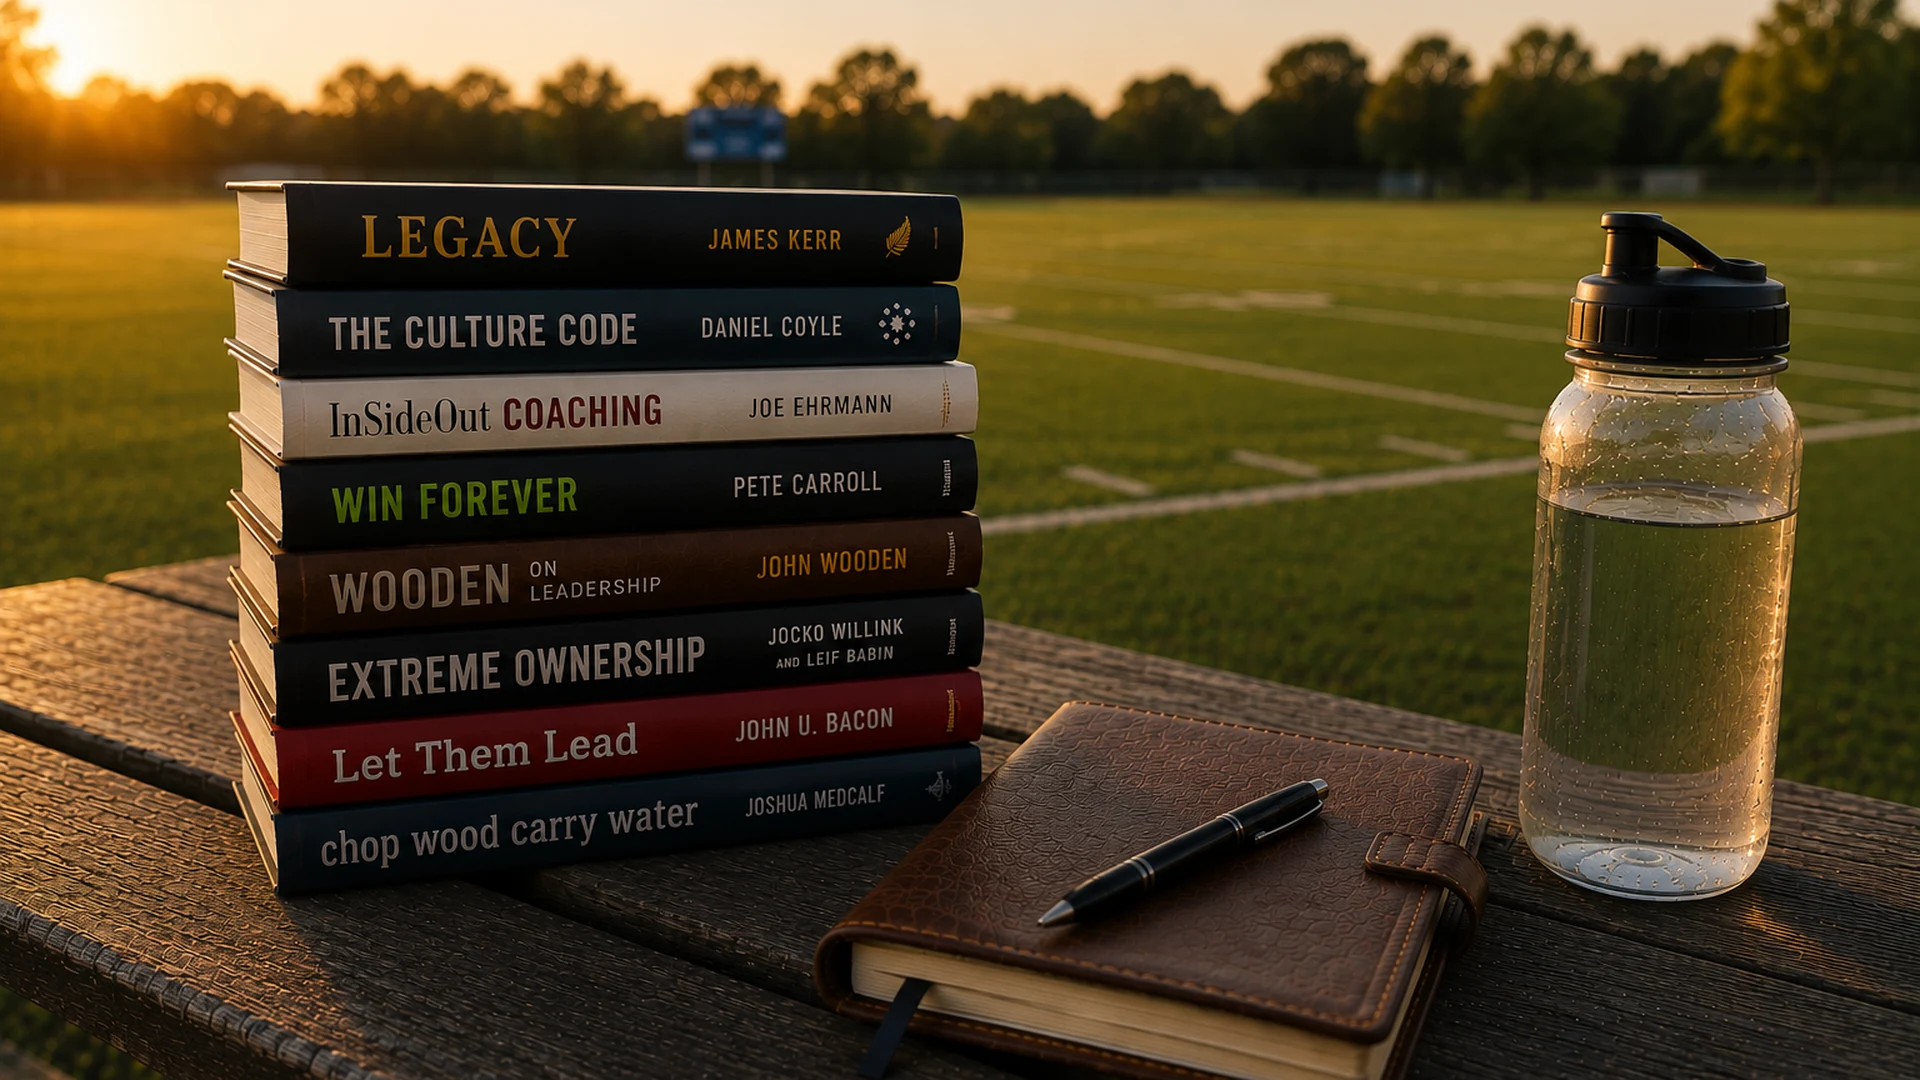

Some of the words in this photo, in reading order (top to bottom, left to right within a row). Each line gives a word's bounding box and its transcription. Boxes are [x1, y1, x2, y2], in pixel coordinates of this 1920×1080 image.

[362, 215, 576, 258] LEGACY
[709, 229, 778, 249] JAMES
[789, 230, 840, 250] KERR
[329, 317, 391, 350] THE
[406, 315, 545, 349] CULTURE
[559, 314, 636, 345] CODE
[702, 317, 773, 338] DANIEL
[782, 316, 841, 336] COYLE
[329, 399, 491, 437] InSideOut
[504, 394, 661, 430] COACHING
[749, 398, 784, 417] JOE
[795, 395, 891, 416] EHRMANN
[332, 485, 402, 523] WIN
[420, 477, 577, 519] FOREVER
[735, 475, 782, 497] PETE
[793, 471, 881, 494] CARROLL
[530, 561, 556, 577] ON
[757, 554, 810, 578] JOHN
[821, 548, 906, 574] WOODEN
[329, 564, 509, 614] WOODEN
[531, 577, 660, 601] LEADERSHIP
[769, 625, 823, 645] JOCKO
[831, 618, 903, 640] WILLINK
[329, 651, 500, 702] EXTREME
[515, 636, 704, 686] OWNERSHIP
[776, 657, 799, 668] AND
[808, 651, 839, 666] LEIF
[847, 646, 893, 662] BABIN
[736, 717, 788, 742] JOHN
[799, 715, 816, 735] U.
[827, 707, 892, 733] BACON
[333, 748, 401, 783] Let
[415, 739, 530, 774] Them
[544, 722, 638, 763] Lead
[746, 793, 807, 817] JOSHUA
[815, 784, 885, 809] MEDCALF
[322, 830, 399, 868] chop
[411, 815, 499, 856] wood
[512, 813, 597, 846] carry
[608, 800, 698, 834] water
